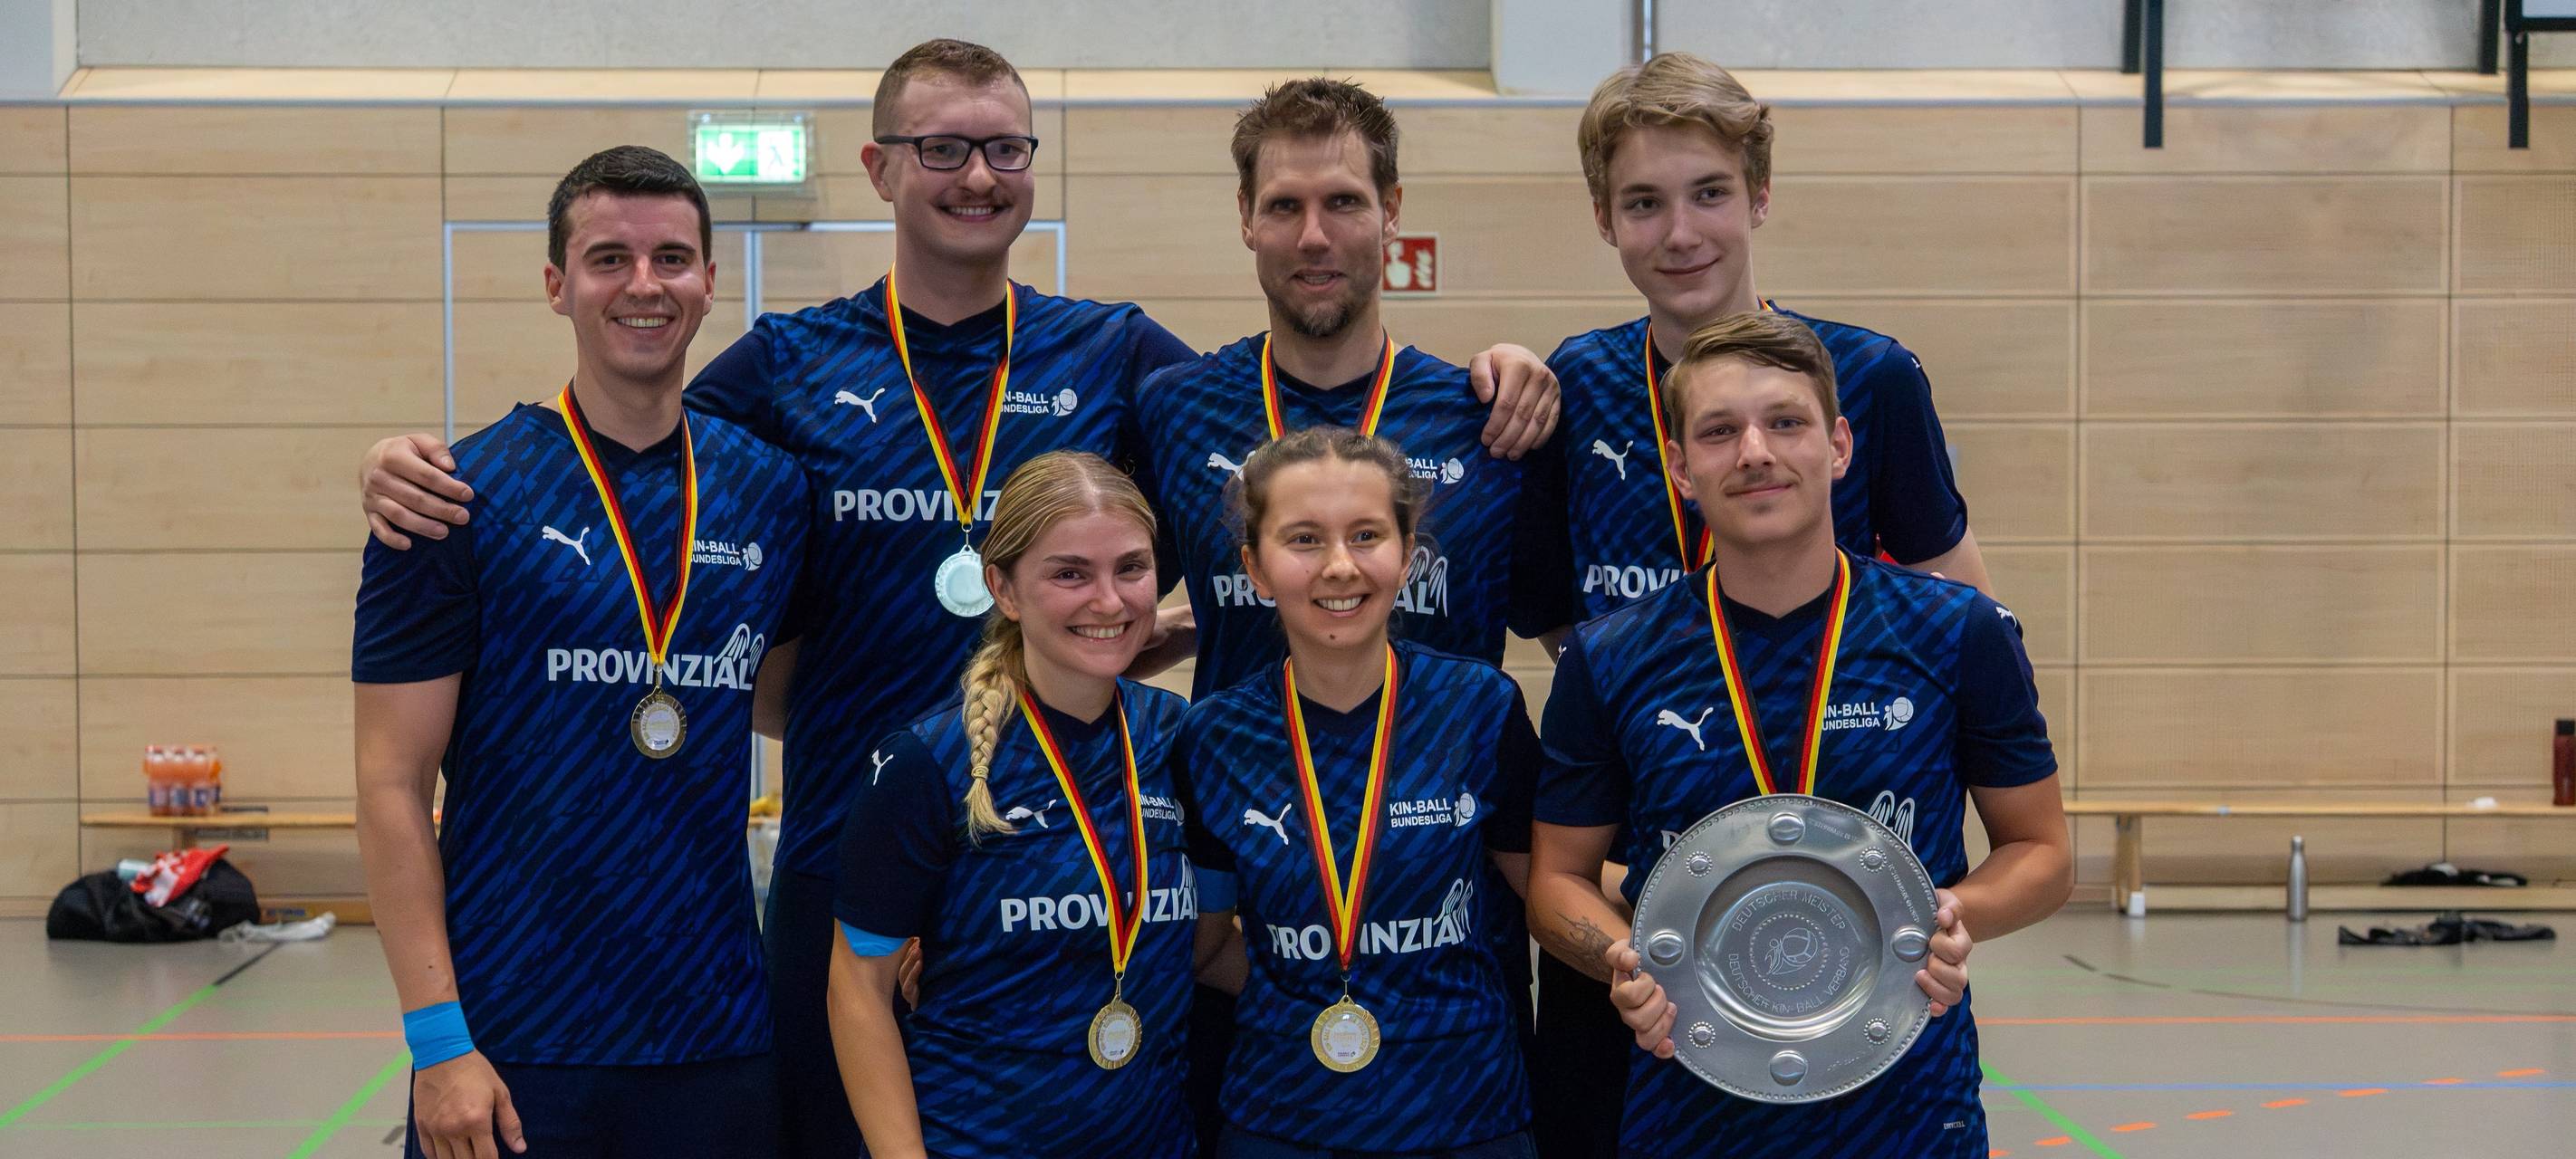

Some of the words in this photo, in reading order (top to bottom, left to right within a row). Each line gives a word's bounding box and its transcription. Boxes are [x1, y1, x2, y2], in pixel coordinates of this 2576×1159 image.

[1003, 390, 1049, 405] N-BALL
[1000, 404, 1050, 414] NDESLIGA
[1405, 457, 1438, 470] BALL
[833, 487, 1002, 522] PROVIZ
[693, 540, 740, 555] IN-BALL
[691, 553, 743, 567] UNDESLIGA
[546, 647, 754, 692] PROVINZIAL
[1823, 702, 1880, 719] IN-BALL
[1821, 717, 1881, 731] UNDESLIGA
[1139, 794, 1175, 809] IN-BALL
[1389, 798, 1452, 817] KIN-BALL
[1141, 807, 1177, 821] UNDESLIGA
[1390, 813, 1453, 829] BUNDESLIGA
[1000, 887, 1199, 933] PROVZIAL
[1732, 890, 1798, 932] DEUTSCHER
[1802, 892, 1846, 930] MEISTER
[1266, 909, 1466, 961] PROINZIAL
[1728, 953, 1771, 1009] DEUTSCHER
